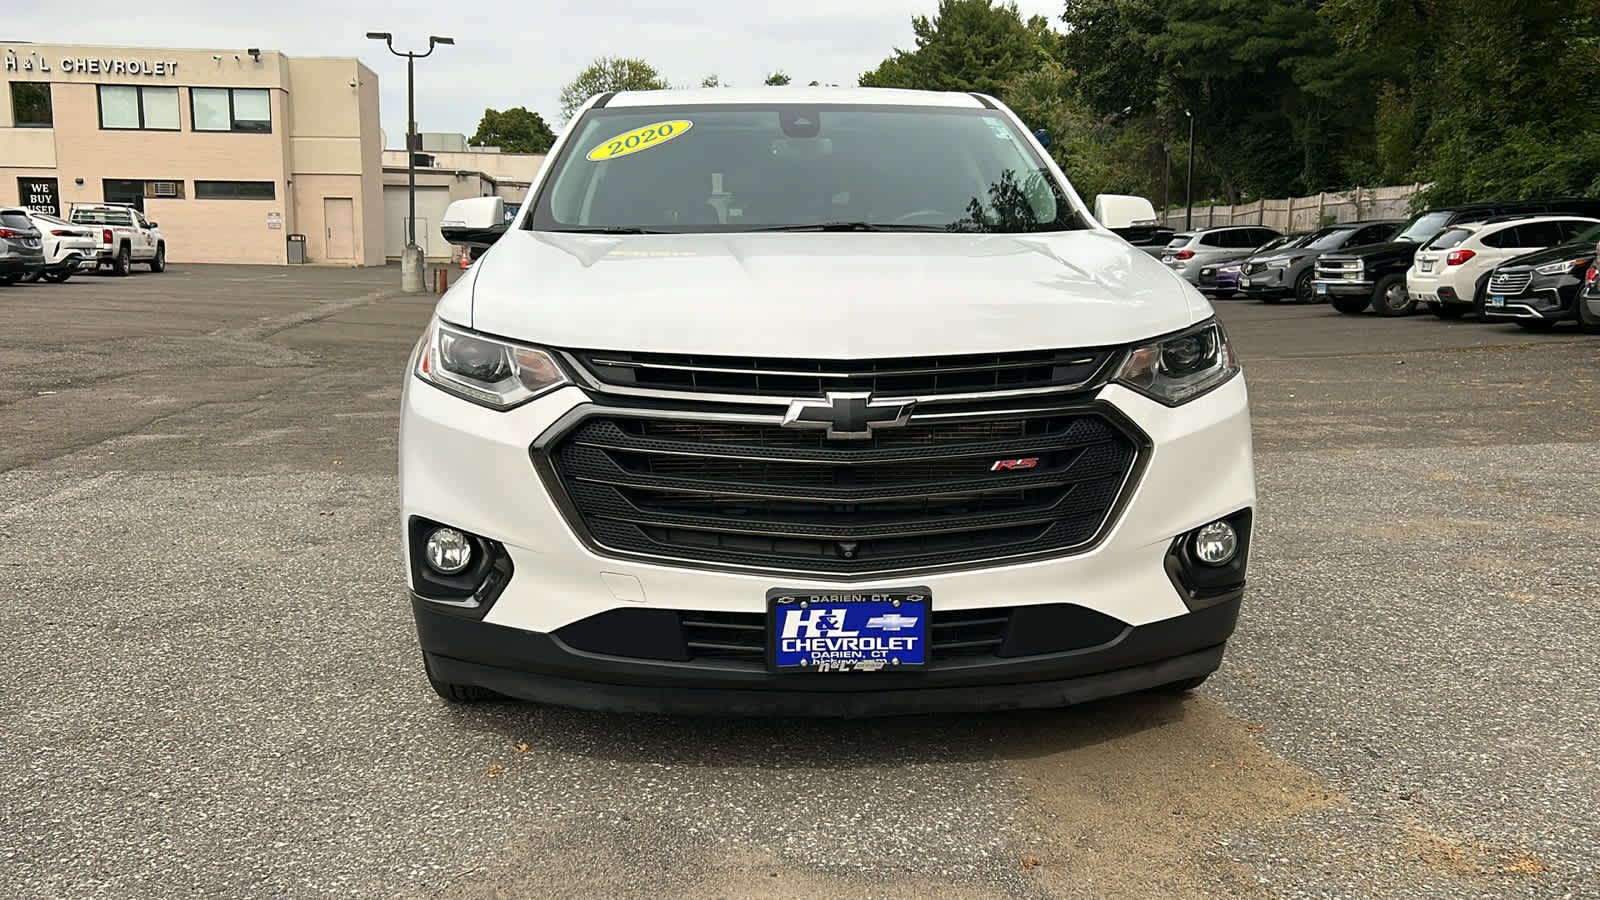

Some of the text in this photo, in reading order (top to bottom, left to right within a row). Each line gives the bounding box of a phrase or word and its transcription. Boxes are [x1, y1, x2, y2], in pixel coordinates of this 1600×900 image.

[5, 56, 177, 75] H & L CHEVROLET
[607, 124, 673, 155] 2020
[31, 183, 49, 193] WE
[30, 194, 52, 204] BUY
[28, 205, 56, 214] USED
[990, 458, 1039, 471] RS
[781, 609, 859, 638] H&L
[782, 637, 918, 652] CHEVROLET
[871, 650, 888, 658] CT
